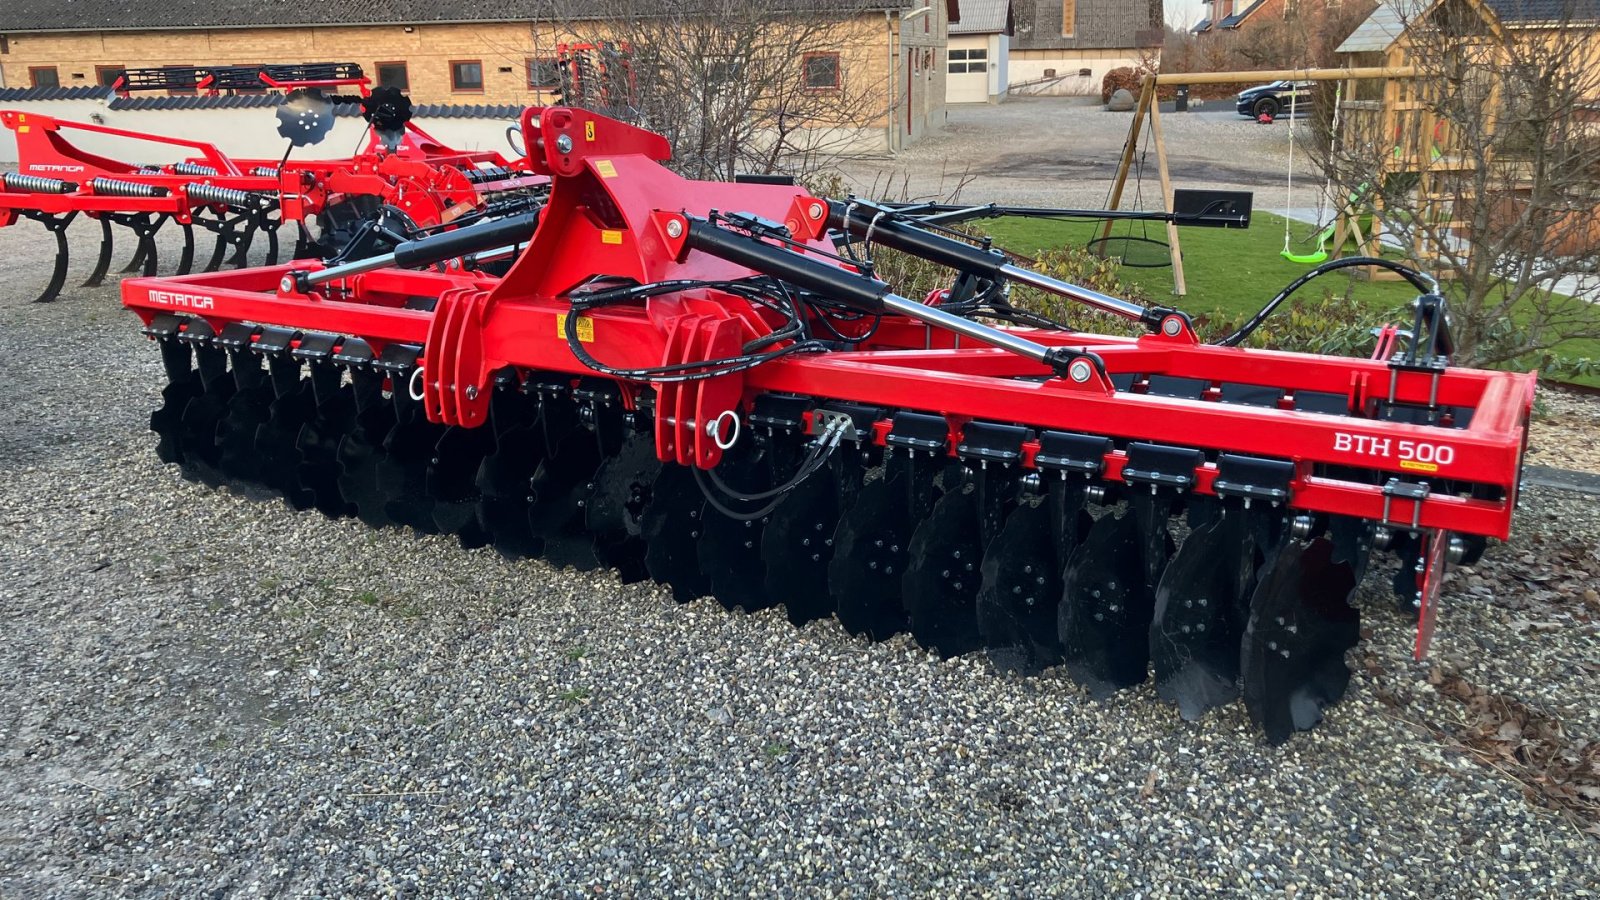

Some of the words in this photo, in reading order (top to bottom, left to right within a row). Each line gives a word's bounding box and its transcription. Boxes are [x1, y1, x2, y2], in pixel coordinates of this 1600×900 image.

[29, 164, 84, 172] METANGA
[149, 290, 214, 309] METANGA
[1333, 432, 1392, 457] BTH
[1398, 441, 1454, 465] 500
